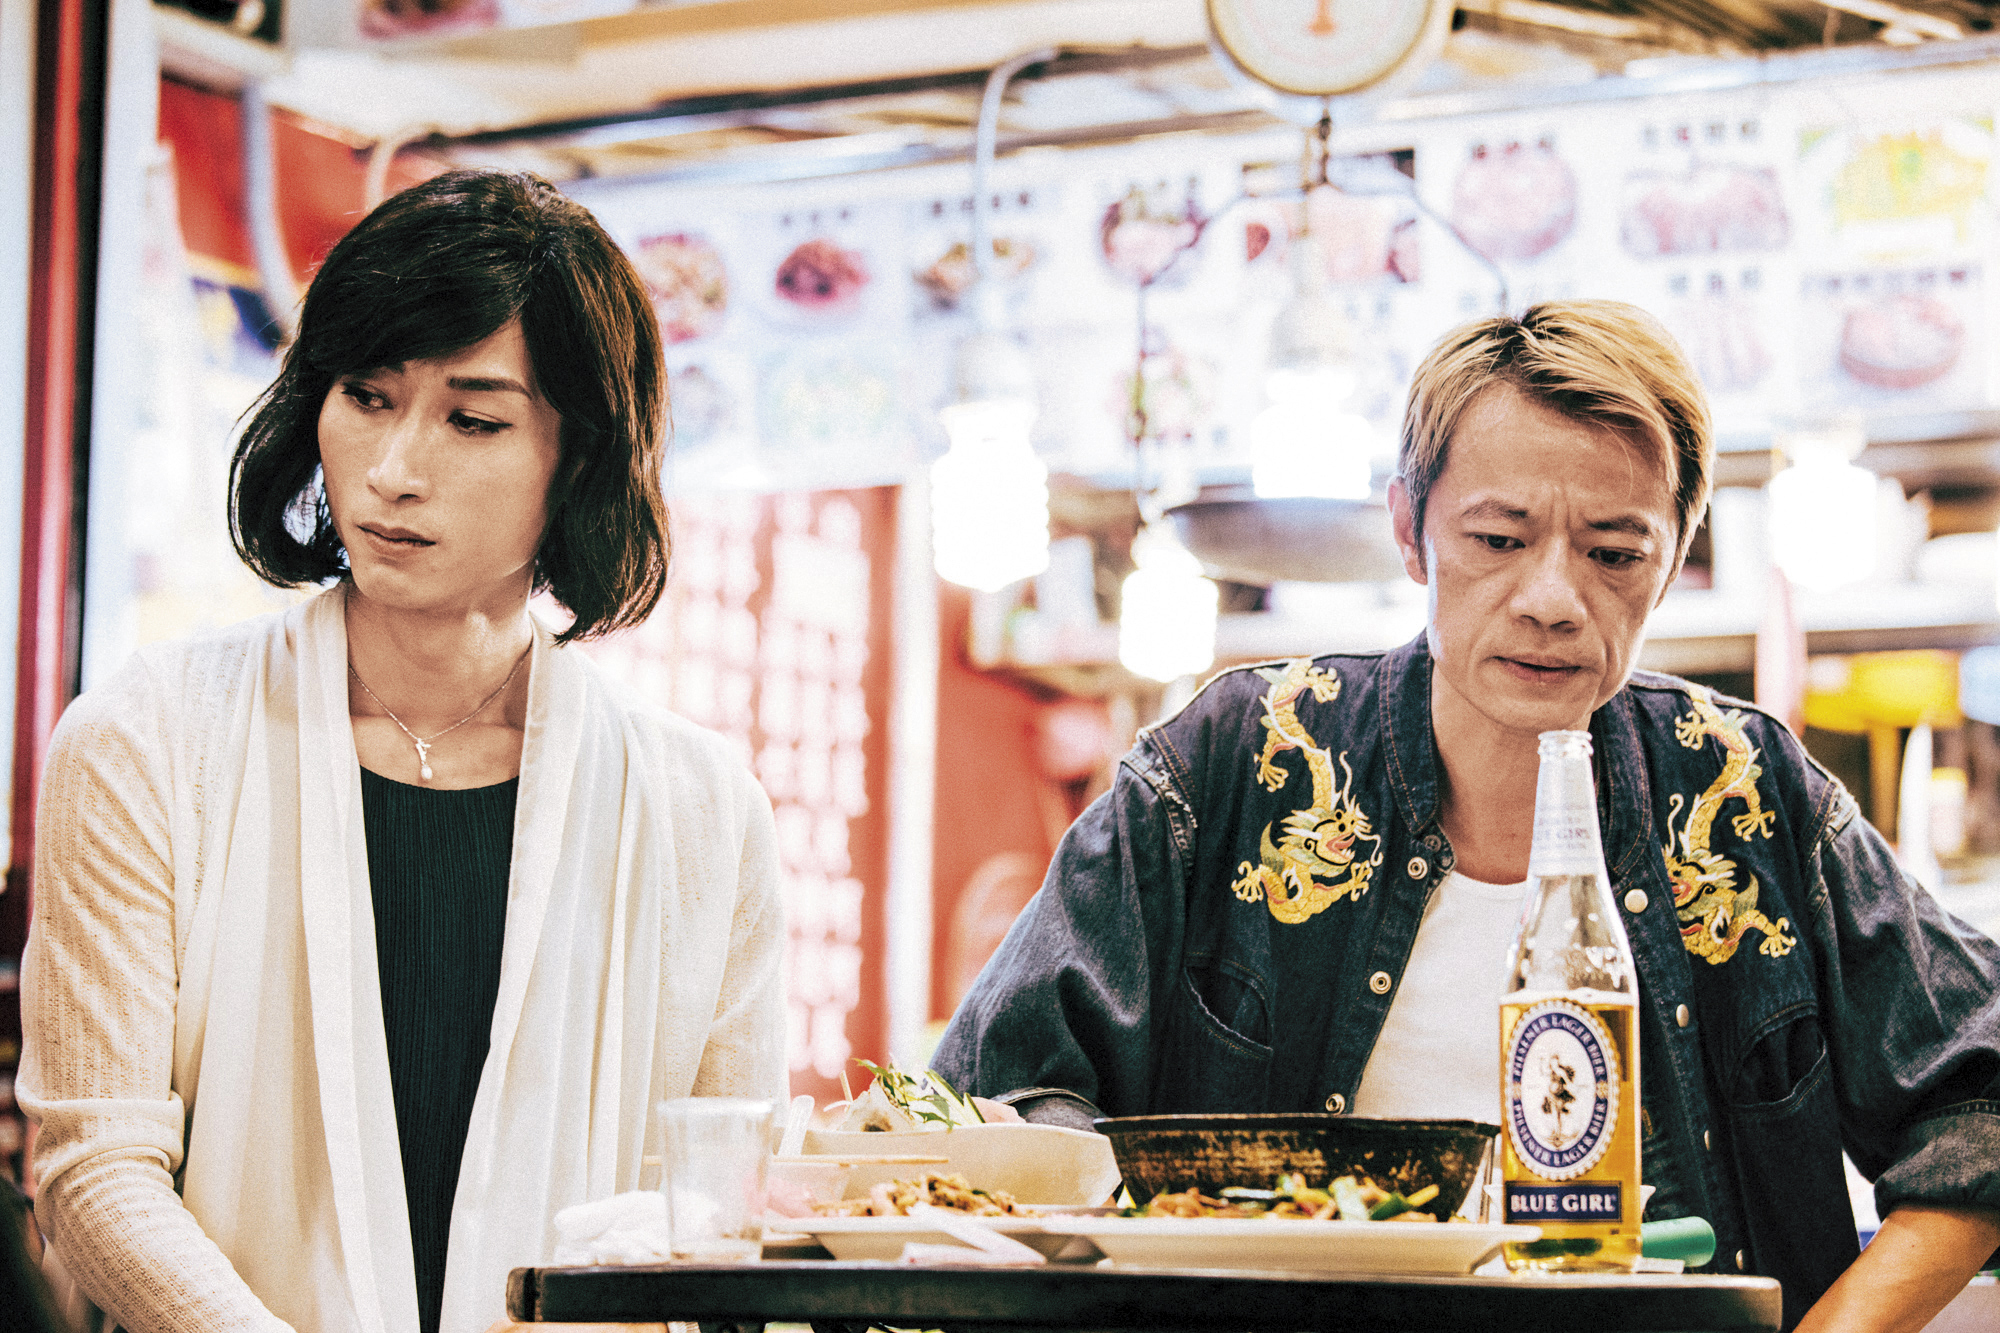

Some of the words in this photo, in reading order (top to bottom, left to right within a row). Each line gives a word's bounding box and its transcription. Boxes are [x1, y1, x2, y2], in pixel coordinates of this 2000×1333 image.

[1551, 1014, 1593, 1046] LAGER
[1586, 1043, 1606, 1076] BIER
[1553, 1135, 1595, 1167] LAGER
[1588, 1102, 1607, 1137] BIER
[1510, 1193, 1560, 1213] BLUE
[1561, 1193, 1616, 1213] GIRL
